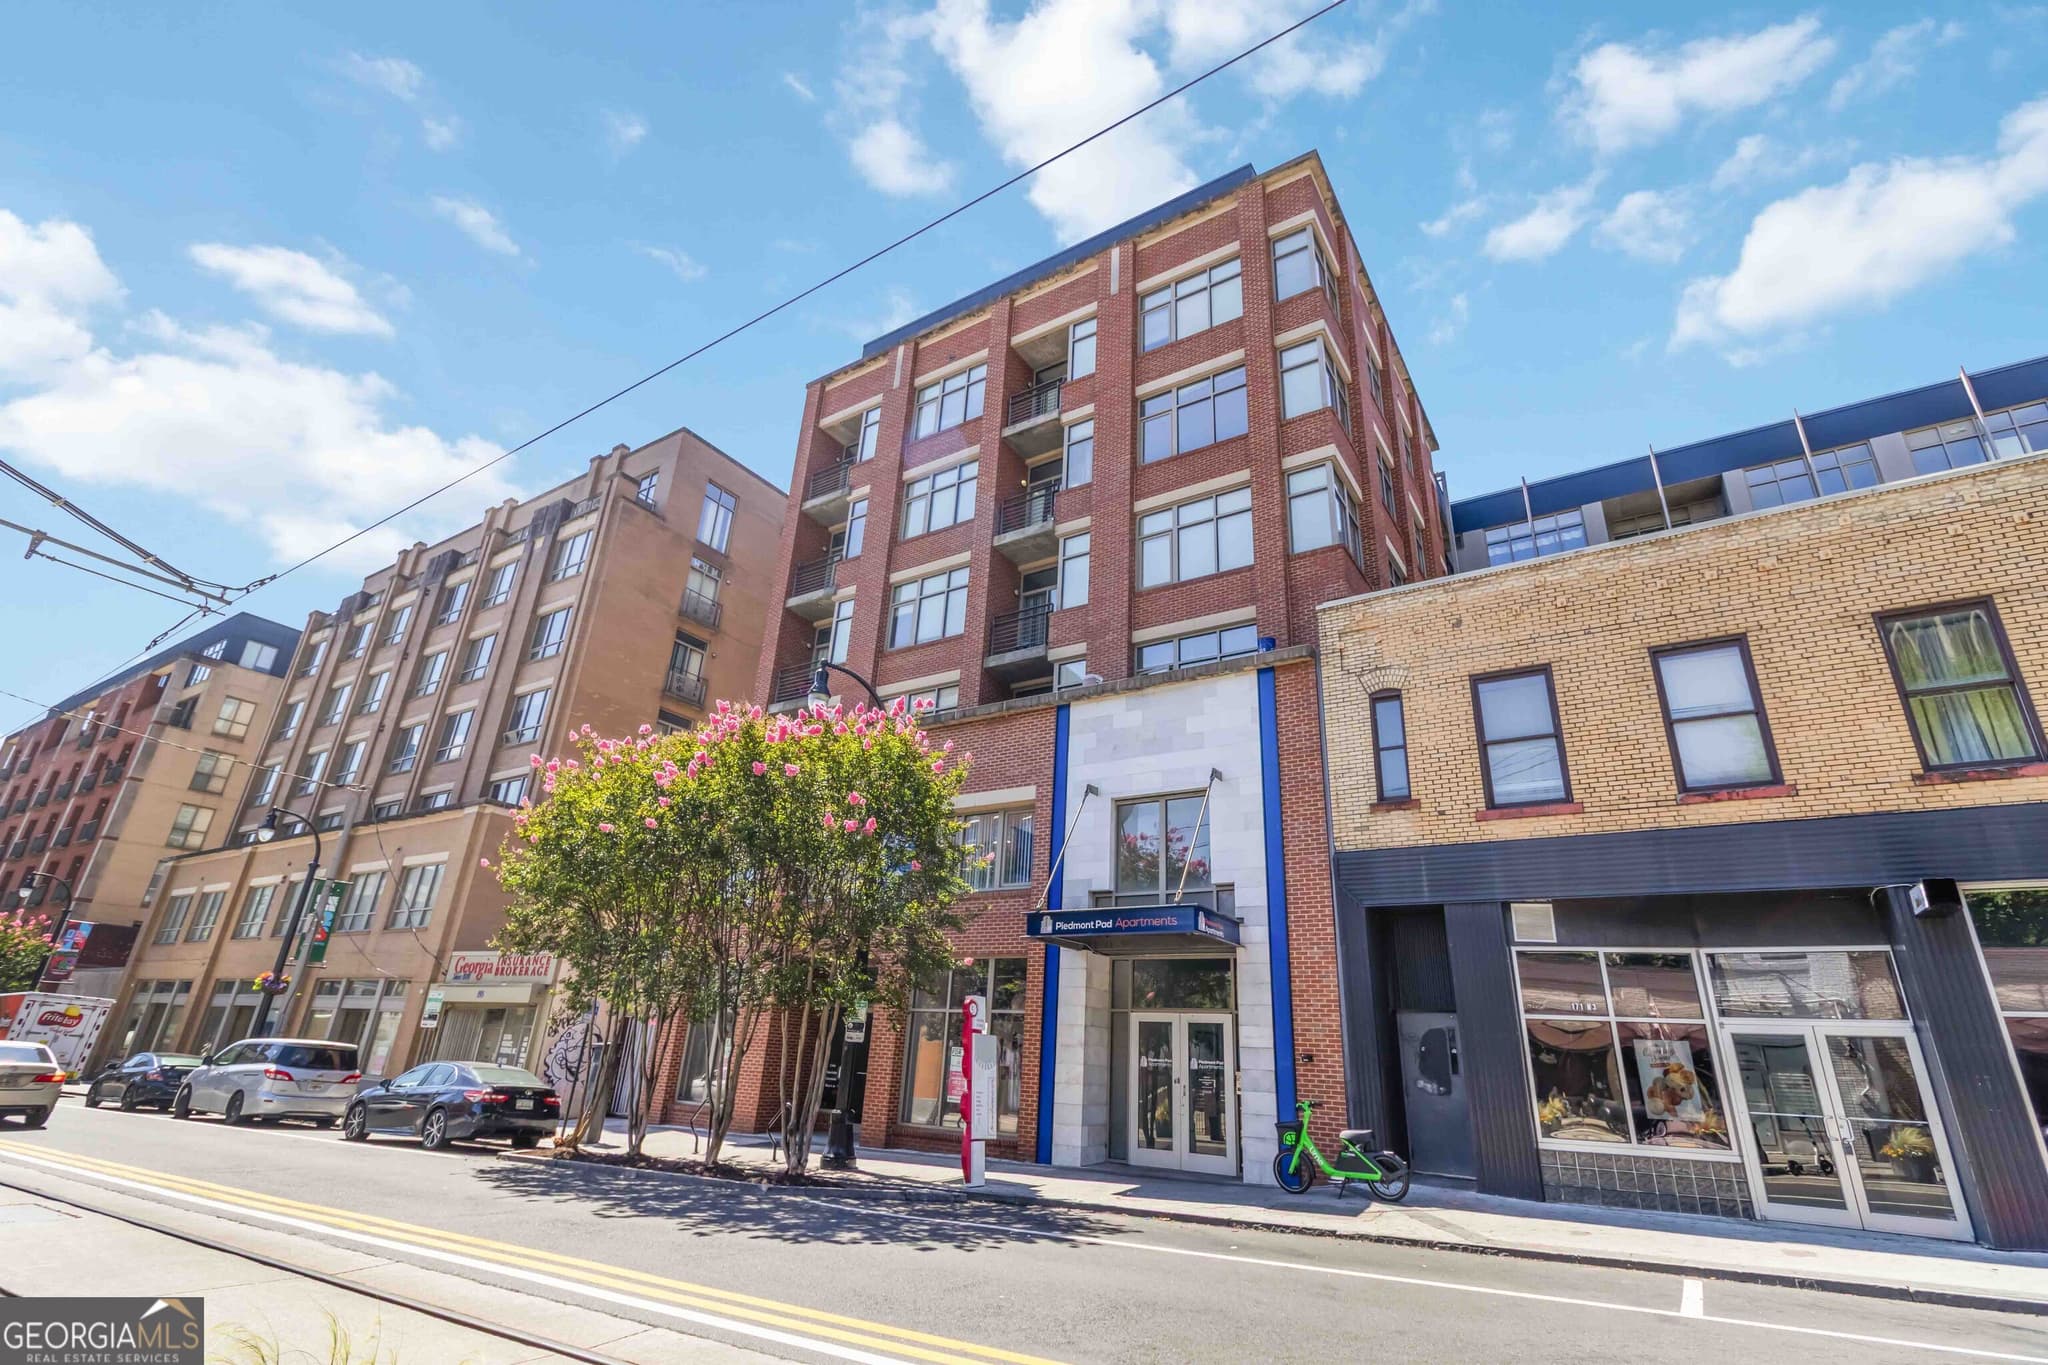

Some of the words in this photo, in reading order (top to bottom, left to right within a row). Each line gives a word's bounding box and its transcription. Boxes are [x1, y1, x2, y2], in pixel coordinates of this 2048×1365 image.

[1056, 920, 1094, 930] Piedmont
[1096, 919, 1113, 928] Pad
[1115, 915, 1178, 928] Apartments
[496, 955, 553, 967] INSURANCE
[455, 956, 494, 980] Georgia
[494, 966, 550, 977] BROKERAGE
